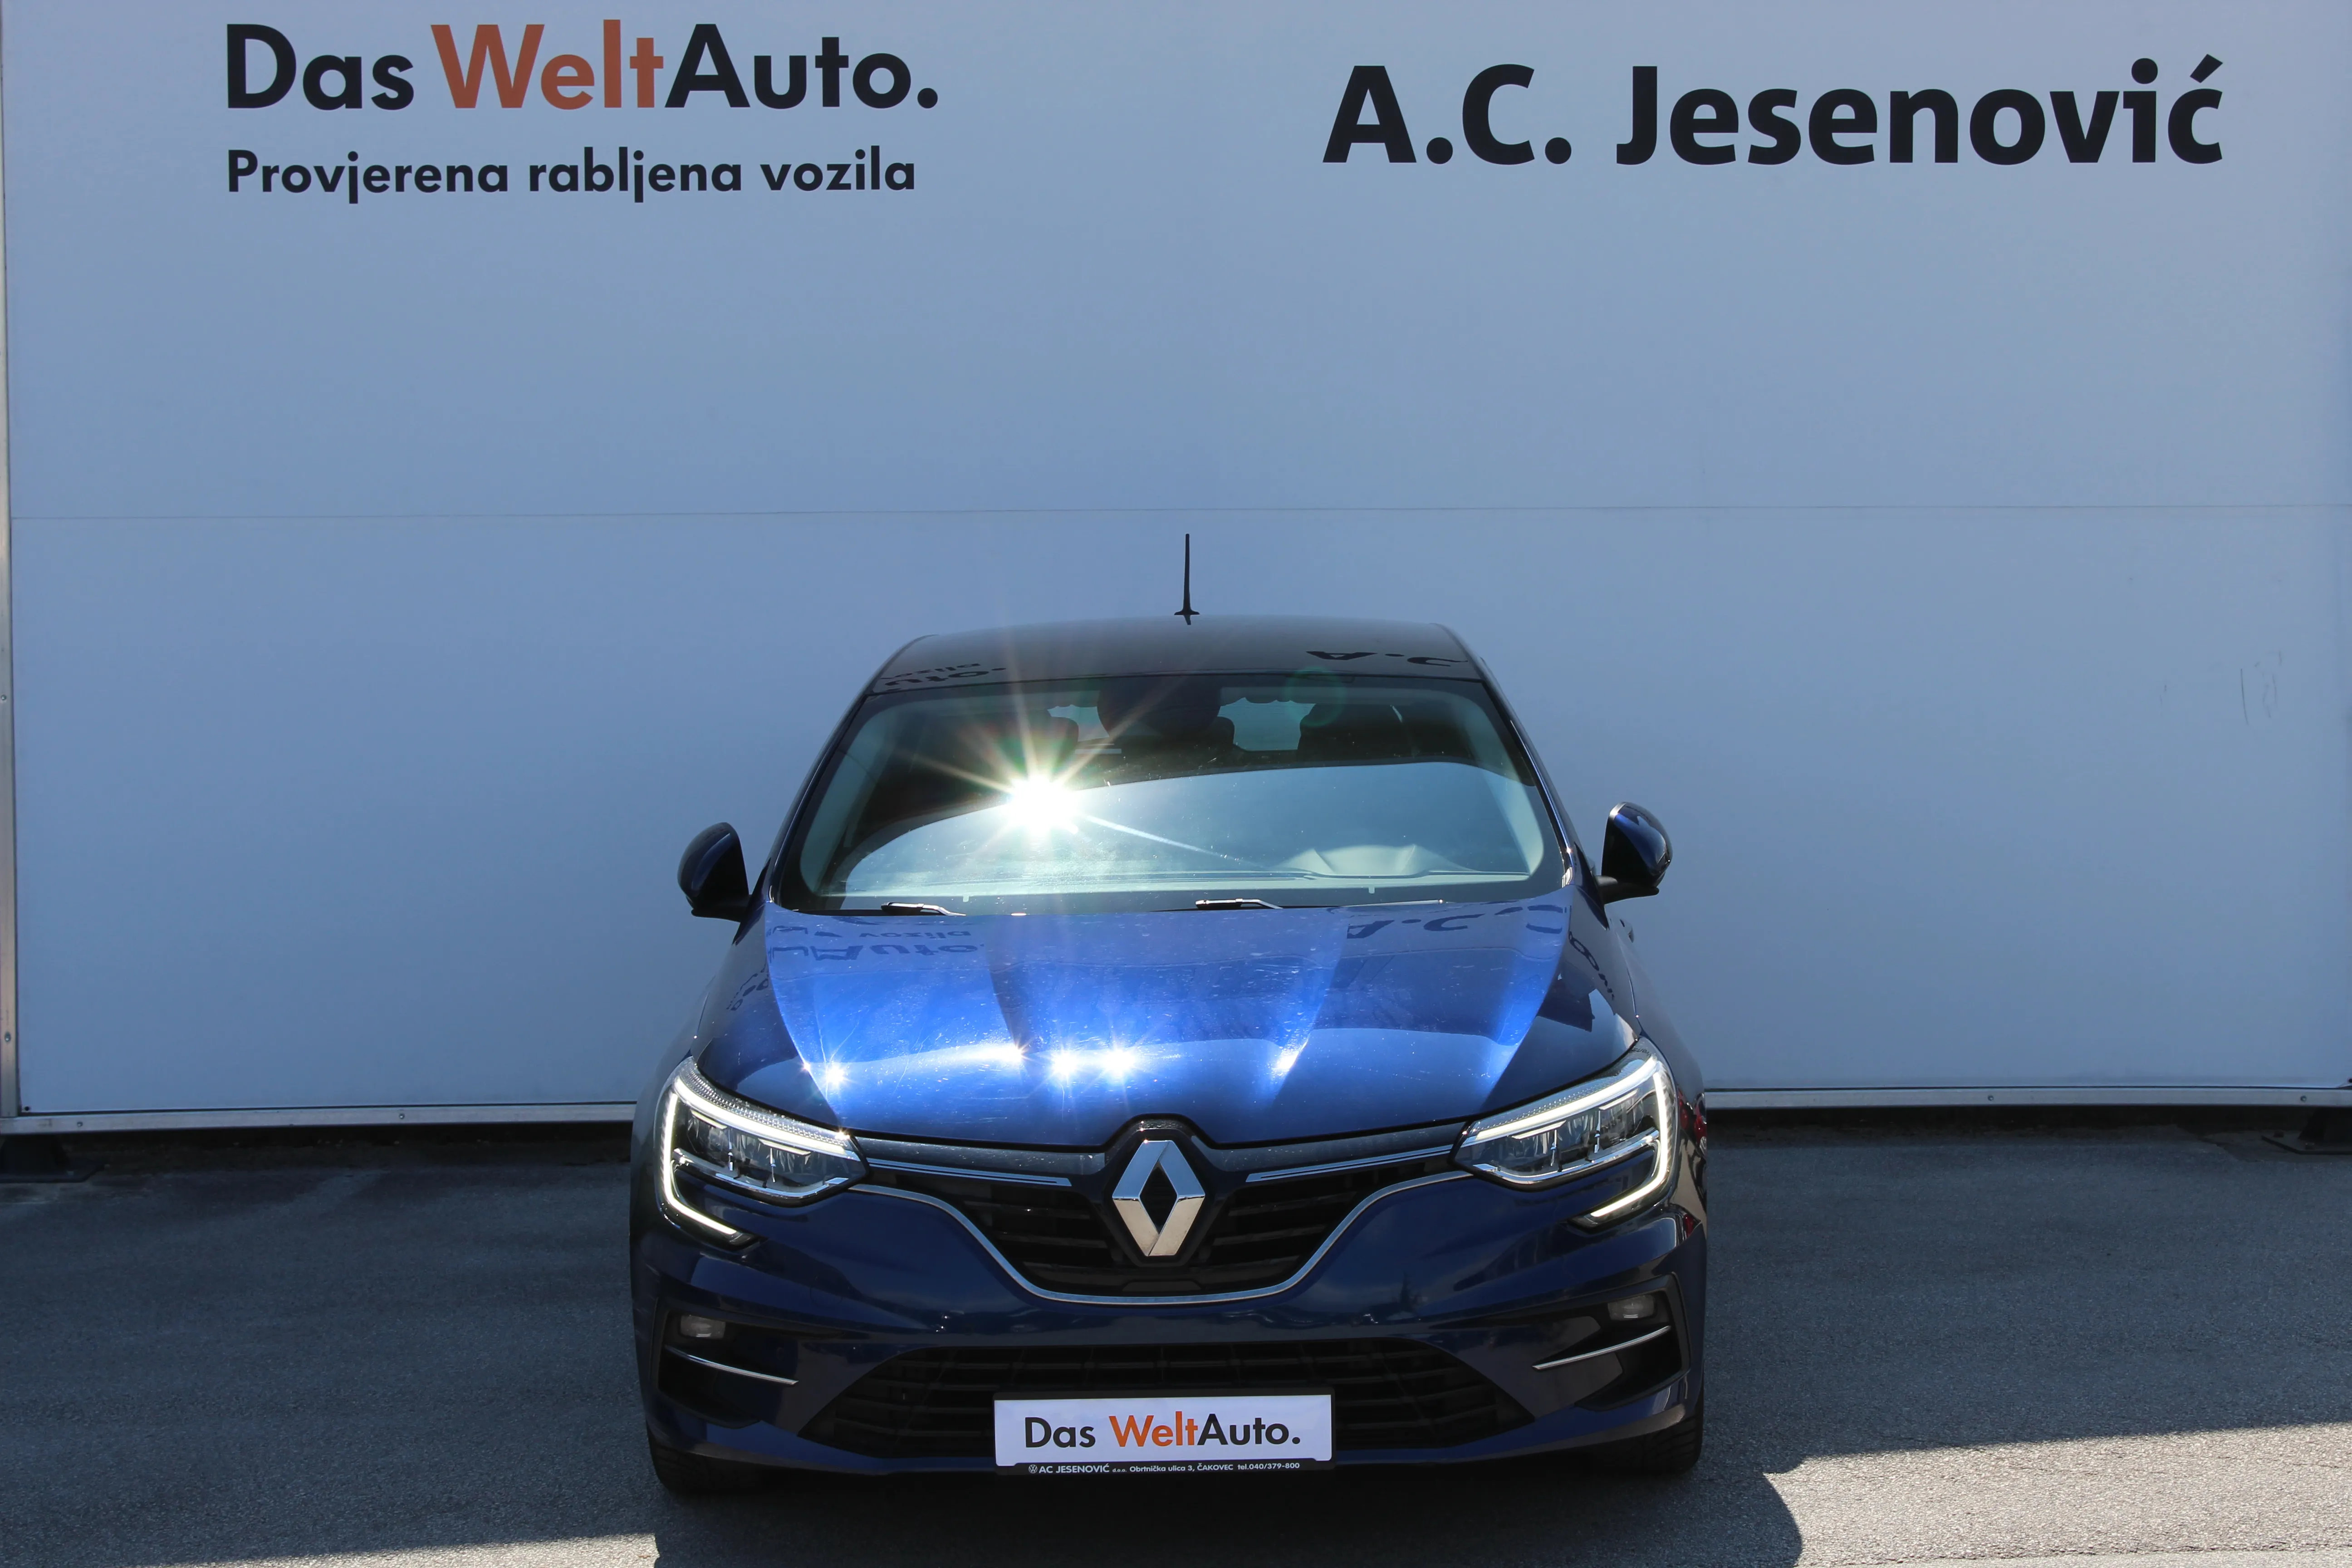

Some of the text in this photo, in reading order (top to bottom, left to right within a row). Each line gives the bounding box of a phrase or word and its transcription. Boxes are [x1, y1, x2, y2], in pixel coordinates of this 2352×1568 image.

[227, 20, 937, 110] Das WeltAuto.
[1323, 54, 2223, 165] A.C. Jesenović
[229, 146, 914, 204] Provjerena rabljena vozila
[1025, 1411, 1301, 1448] Das WeltAuto.
[1056, 1463, 1110, 1473] JESENOVIĆ
[1197, 1462, 1233, 1471] ČAKOVEC
[1238, 1462, 1300, 1470] tel.040/379-800
